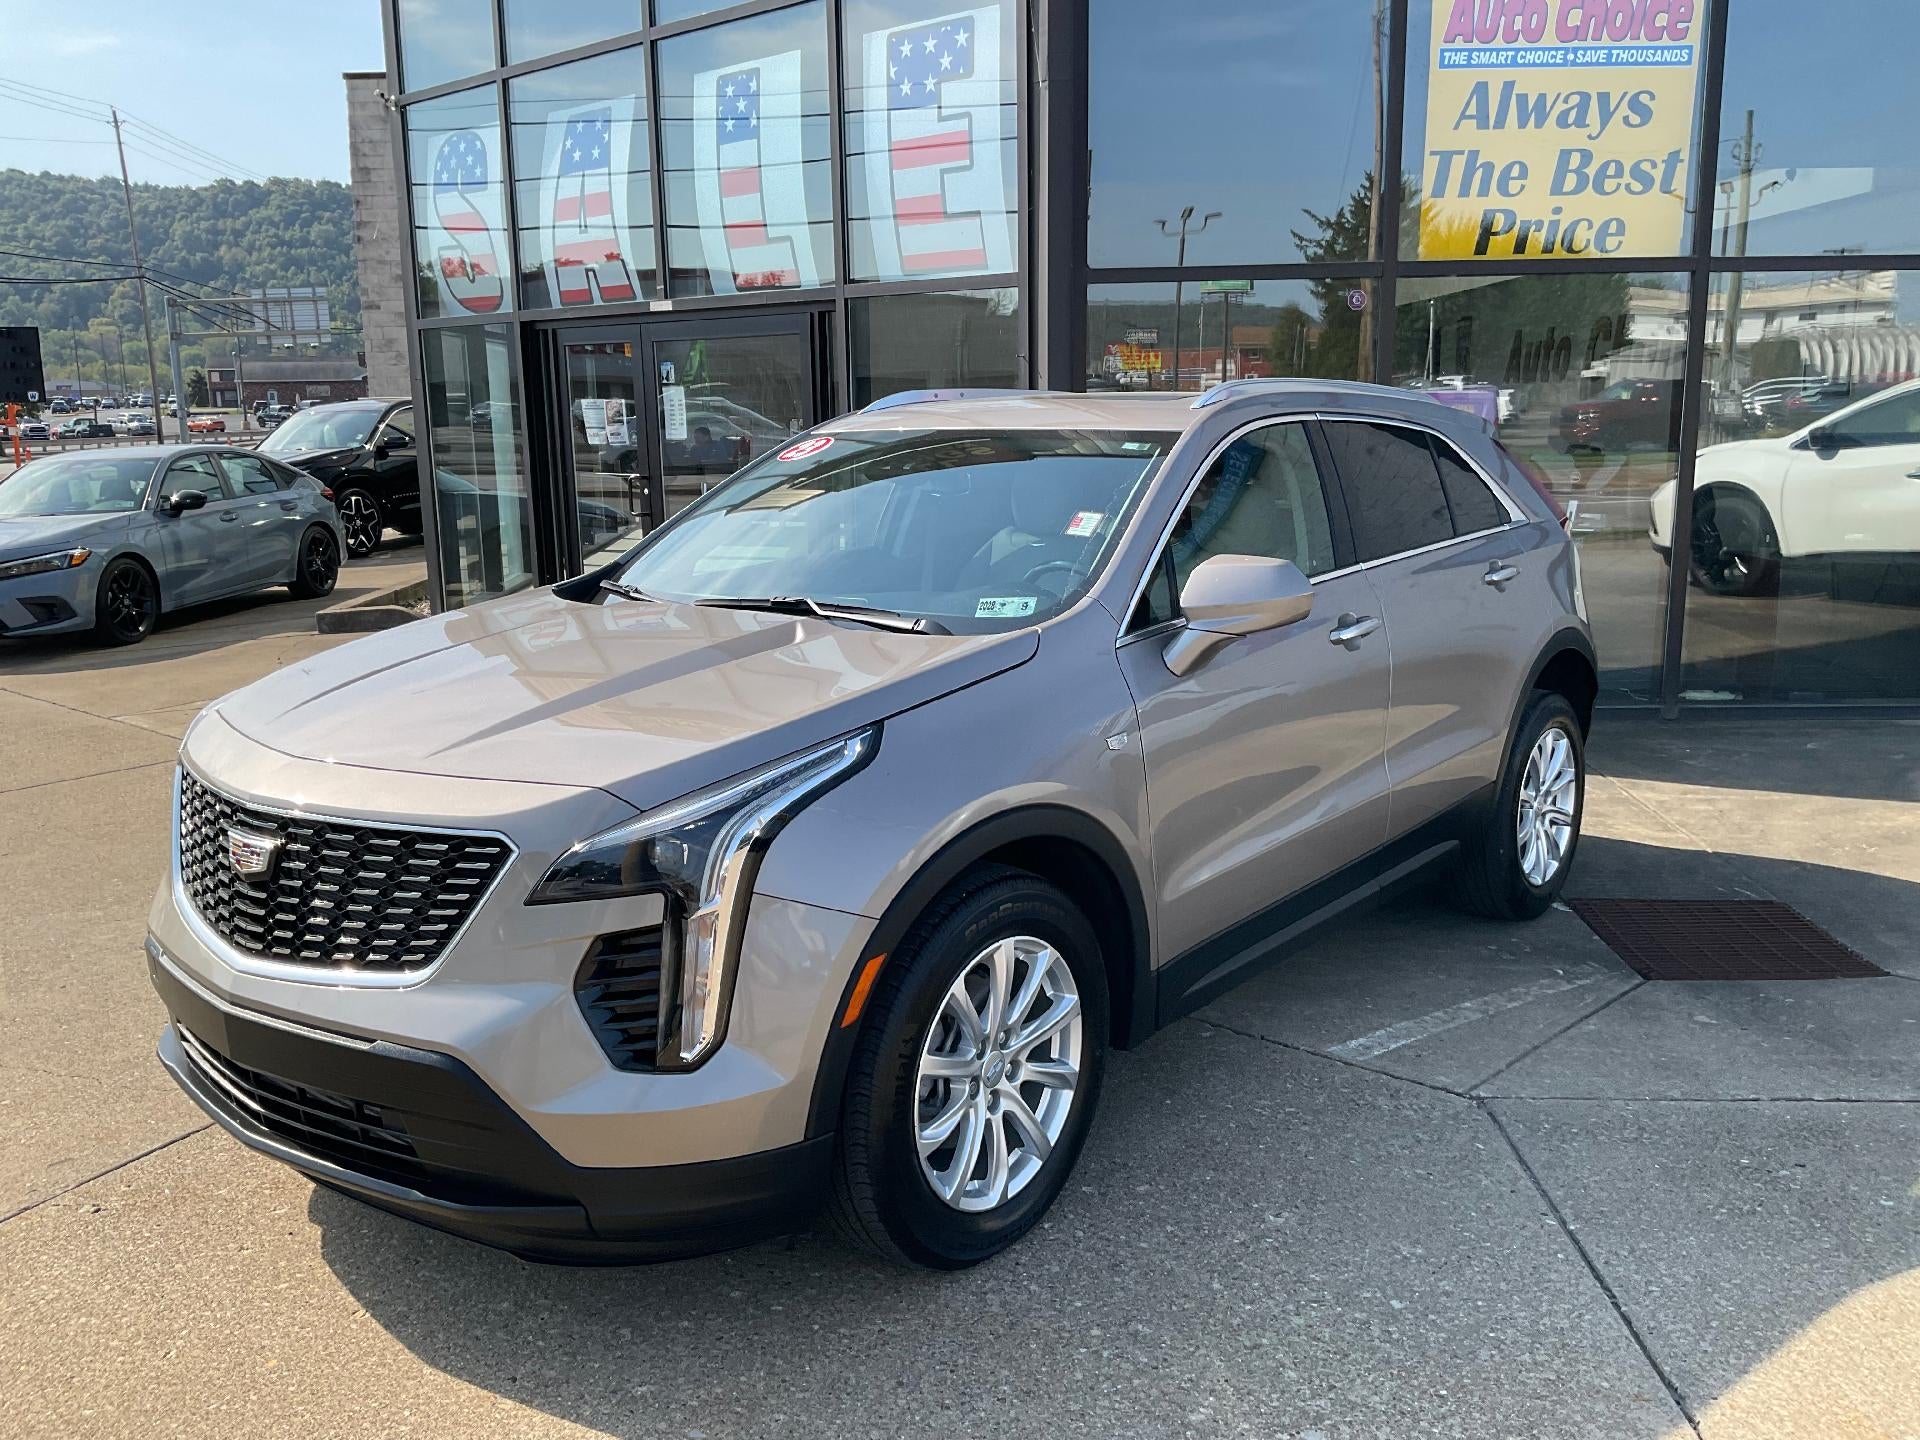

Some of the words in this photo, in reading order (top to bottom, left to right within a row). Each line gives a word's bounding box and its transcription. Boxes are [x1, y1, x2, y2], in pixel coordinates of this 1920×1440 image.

[1443, 51, 1468, 64] THE
[1471, 51, 1514, 64] SMART
[1517, 50, 1564, 64] CHOICE
[1576, 50, 1607, 63] SAVE
[1611, 49, 1689, 62] THOUSANDS
[1453, 80, 1656, 140] Always
[433, 15, 988, 314] SALE
[1429, 149, 1528, 198] The
[1549, 147, 1684, 196] Best
[1473, 206, 1626, 256] Price
[1503, 326, 1572, 384] Auto
